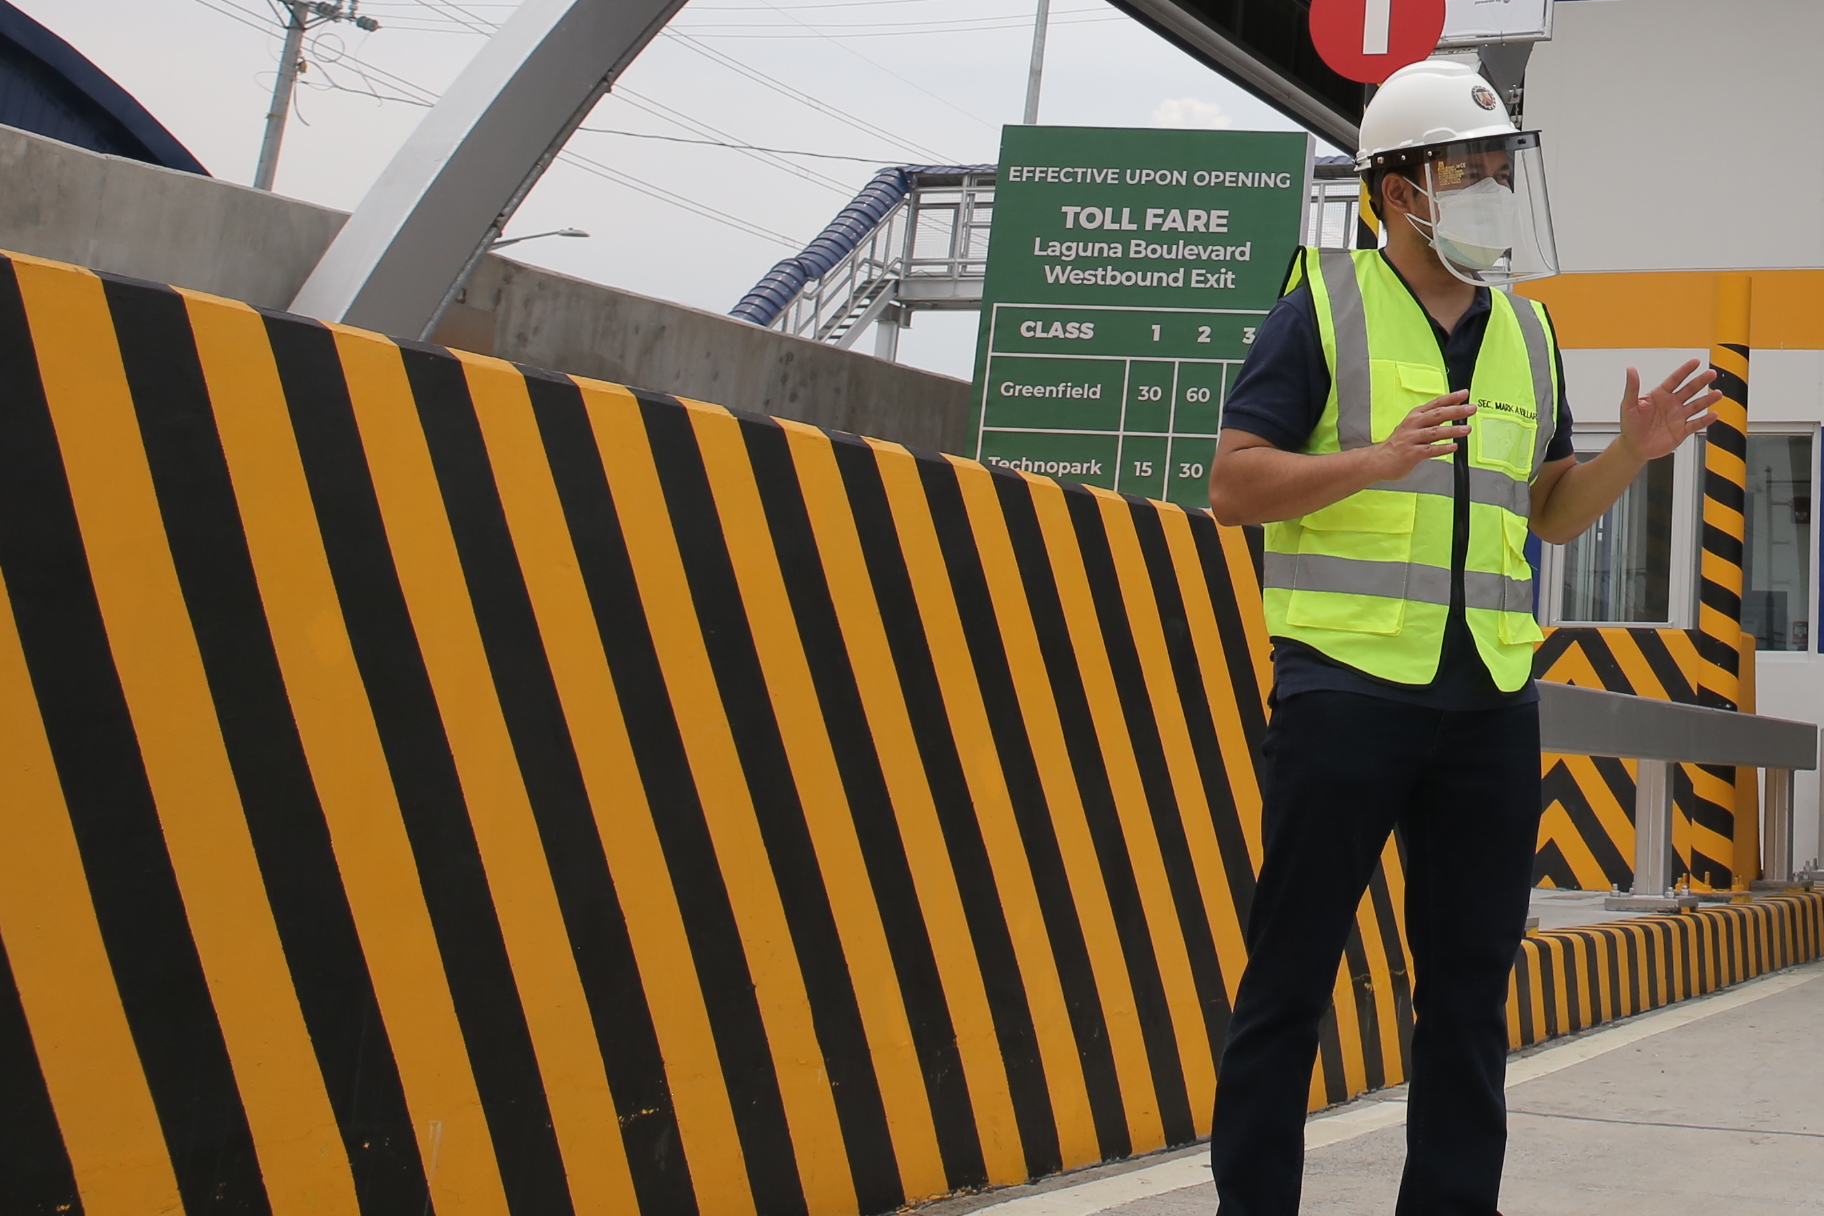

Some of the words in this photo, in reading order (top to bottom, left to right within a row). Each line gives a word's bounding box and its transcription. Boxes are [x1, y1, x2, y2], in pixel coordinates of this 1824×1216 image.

[1008, 166, 1119, 184] EFFECTIVE
[1125, 169, 1187, 186] UPON
[1193, 170, 1291, 188] OPENING
[1061, 206, 1137, 231] TOLL
[1144, 208, 1229, 233] FARE
[1034, 237, 1122, 262] Laguna
[1129, 239, 1251, 261] Boulevard
[1044, 265, 1184, 287] Westbound
[1190, 268, 1236, 289] Exit
[1020, 320, 1095, 340] CLASS
[1151, 325, 1161, 341] 1
[1197, 326, 1211, 343] 2
[1242, 327, 1256, 344] 3
[1000, 381, 1101, 399] Greenfield
[1137, 386, 1162, 401] 30
[1186, 387, 1211, 402] 60
[1477, 398, 1493, 409] SEC.
[1494, 401, 1514, 413] MARK
[988, 456, 1102, 476] Technopark
[1134, 461, 1153, 476] 15
[1179, 463, 1204, 478] 30
